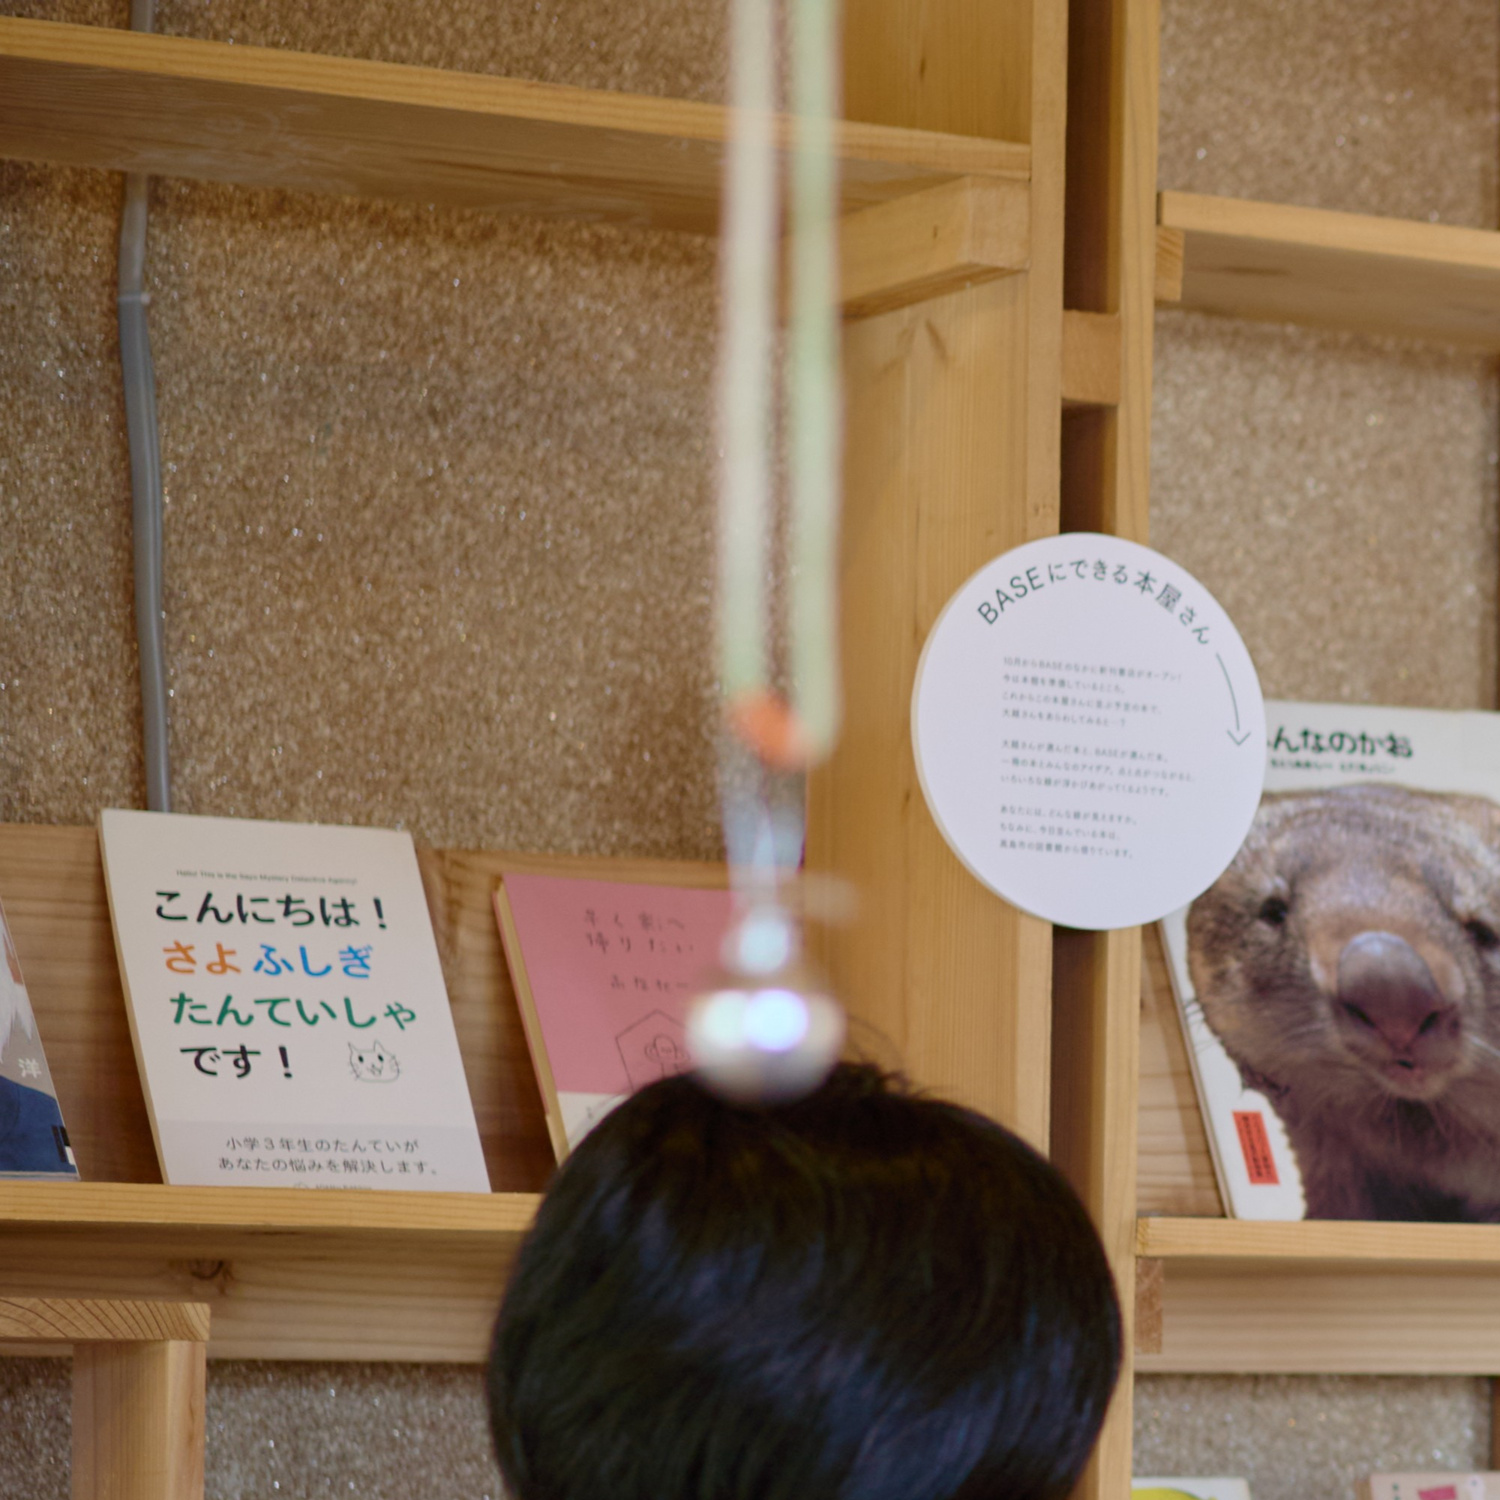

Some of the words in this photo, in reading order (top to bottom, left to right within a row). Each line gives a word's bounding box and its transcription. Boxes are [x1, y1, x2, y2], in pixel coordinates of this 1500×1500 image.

[976, 558, 1211, 646] BASEにできる本屋さん
[1267, 727, 1413, 757] んなのかお
[155, 890, 388, 930] こんにちは！
[171, 992, 417, 1030] たんていしゃ
[180, 1045, 293, 1079] です！
[226, 1137, 419, 1153] 小学３年生のたんていが
[218, 1157, 437, 1175] あなたの悩みを解決します。
